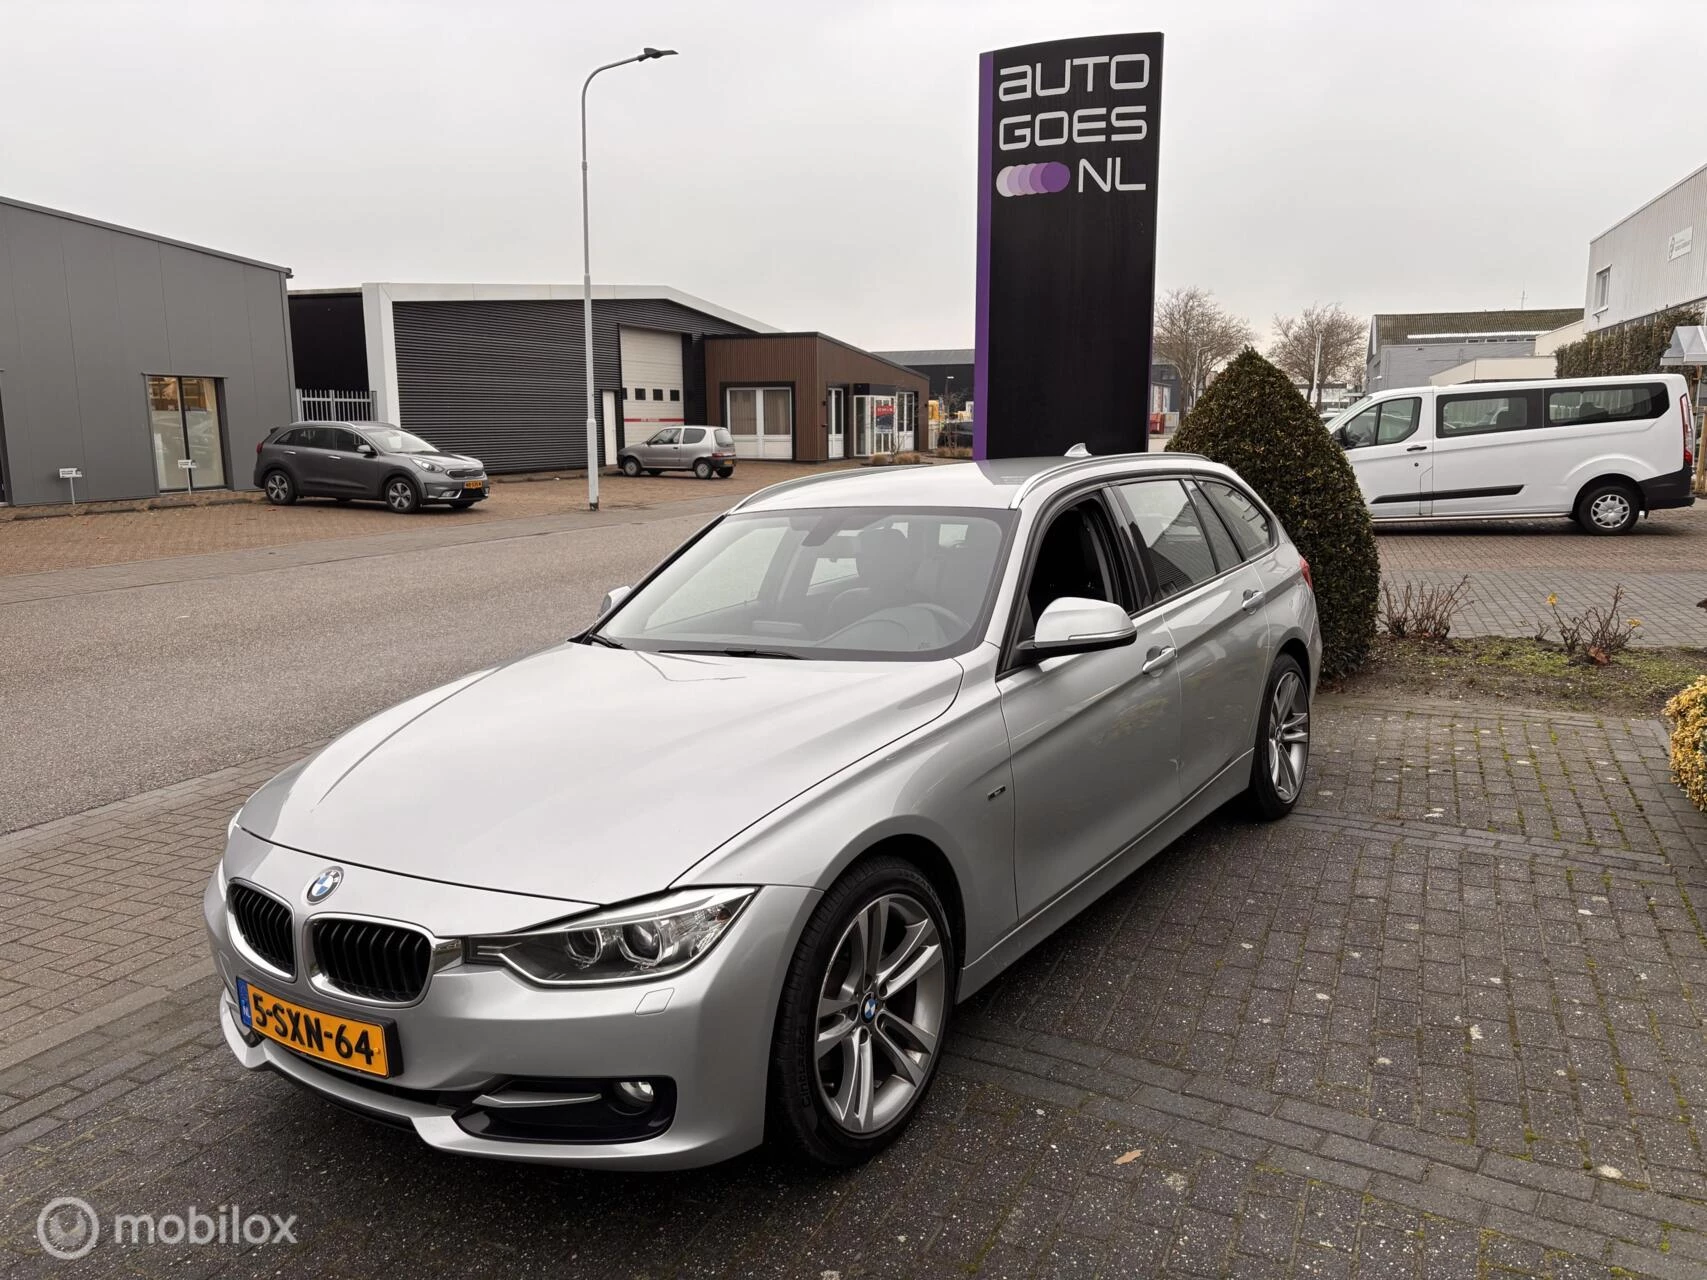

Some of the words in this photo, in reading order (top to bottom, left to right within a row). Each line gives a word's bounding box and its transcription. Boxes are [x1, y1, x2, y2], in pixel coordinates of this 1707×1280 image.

[999, 105, 1147, 151] GOES
[1078, 156, 1147, 193] NL
[253, 993, 374, 1065] 5-SXN-64
